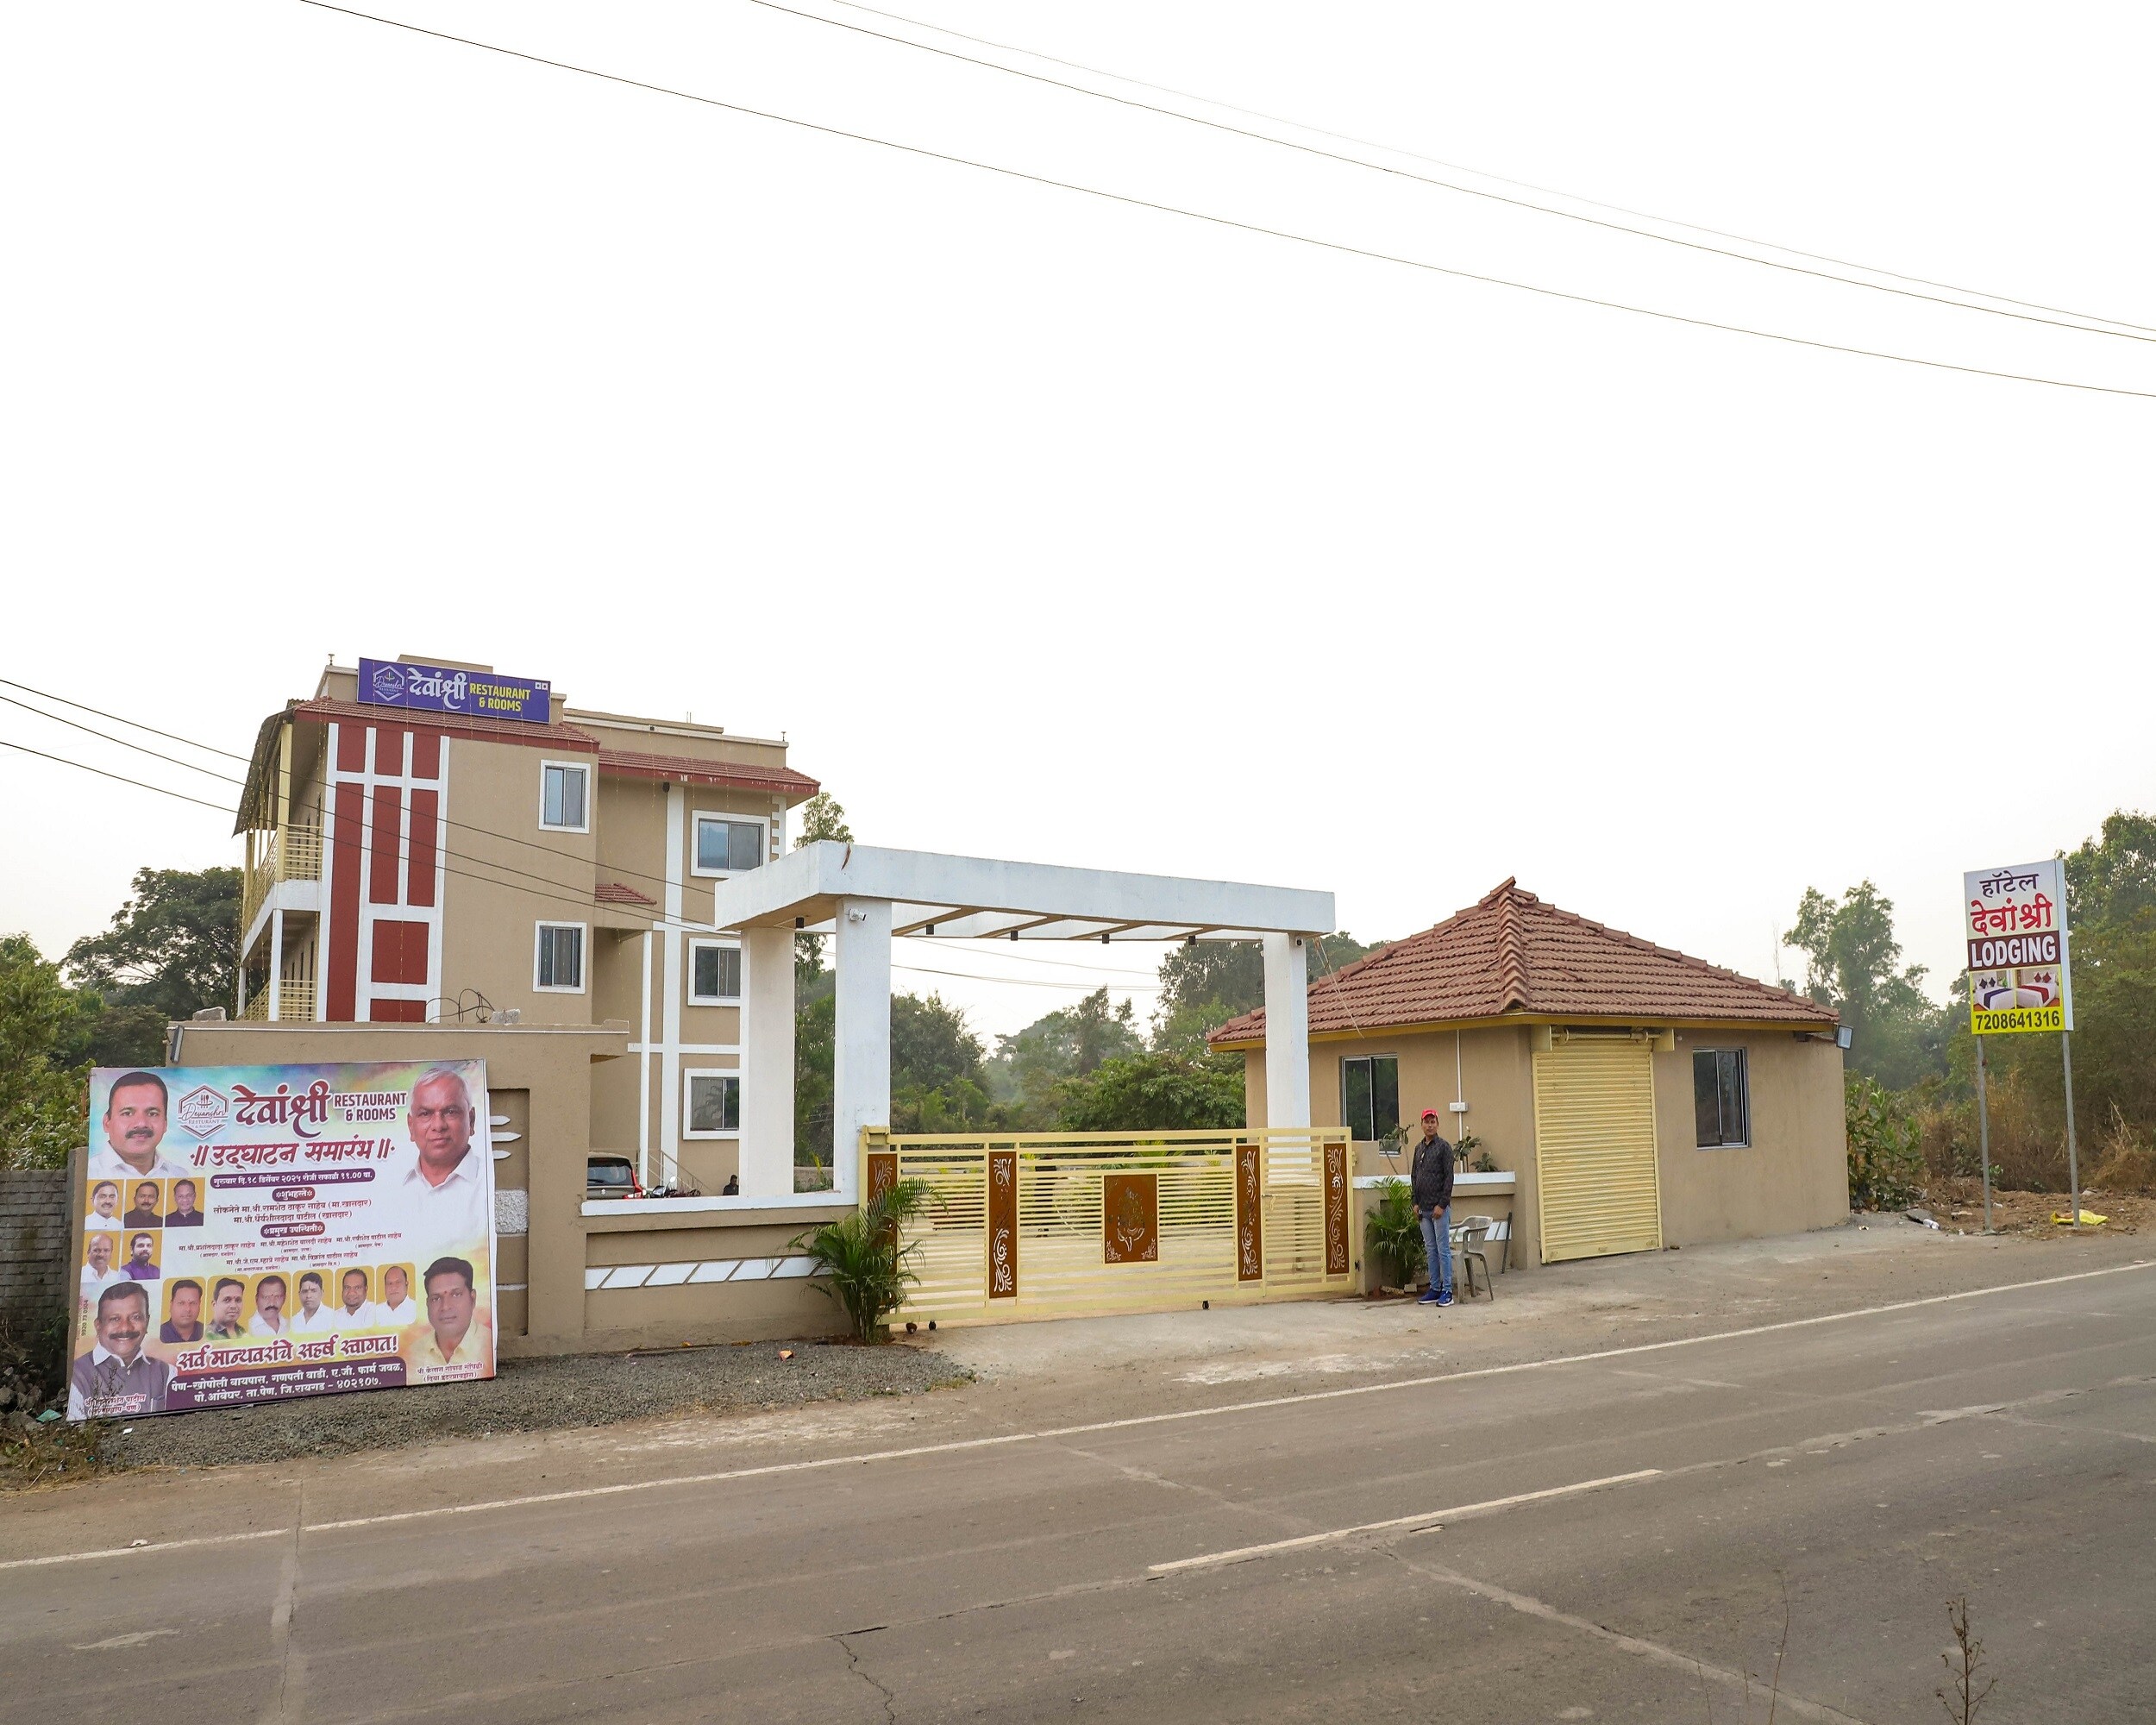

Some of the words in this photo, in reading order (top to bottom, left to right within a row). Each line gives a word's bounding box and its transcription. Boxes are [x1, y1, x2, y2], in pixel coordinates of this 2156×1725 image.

[407, 667, 467, 710] देवांश्री
[470, 682, 530, 700] RESTAURANT
[479, 698, 485, 708] &
[488, 699, 521, 712] ROOMS
[1979, 870, 2040, 898] हॉटेल
[1970, 893, 2053, 936] देवांश्री
[1971, 935, 2056, 968] LODGING
[1976, 1010, 2060, 1031] 7208641316
[231, 1080, 332, 1138] देवांश्री
[335, 1093, 407, 1107] RESTAURANT
[346, 1108, 353, 1120] &
[356, 1107, 396, 1120] ROOMS
[304, 1134, 374, 1161] समारंभ
[178, 1344, 210, 1369] सर्व
[210, 1339, 293, 1365] मान्यवरांचे
[298, 1334, 339, 1358] सहर्ष
[341, 1335, 397, 1355] स्वागत!
[272, 1370, 304, 1382] गणपती
[358, 1362, 376, 1374] फार्म
